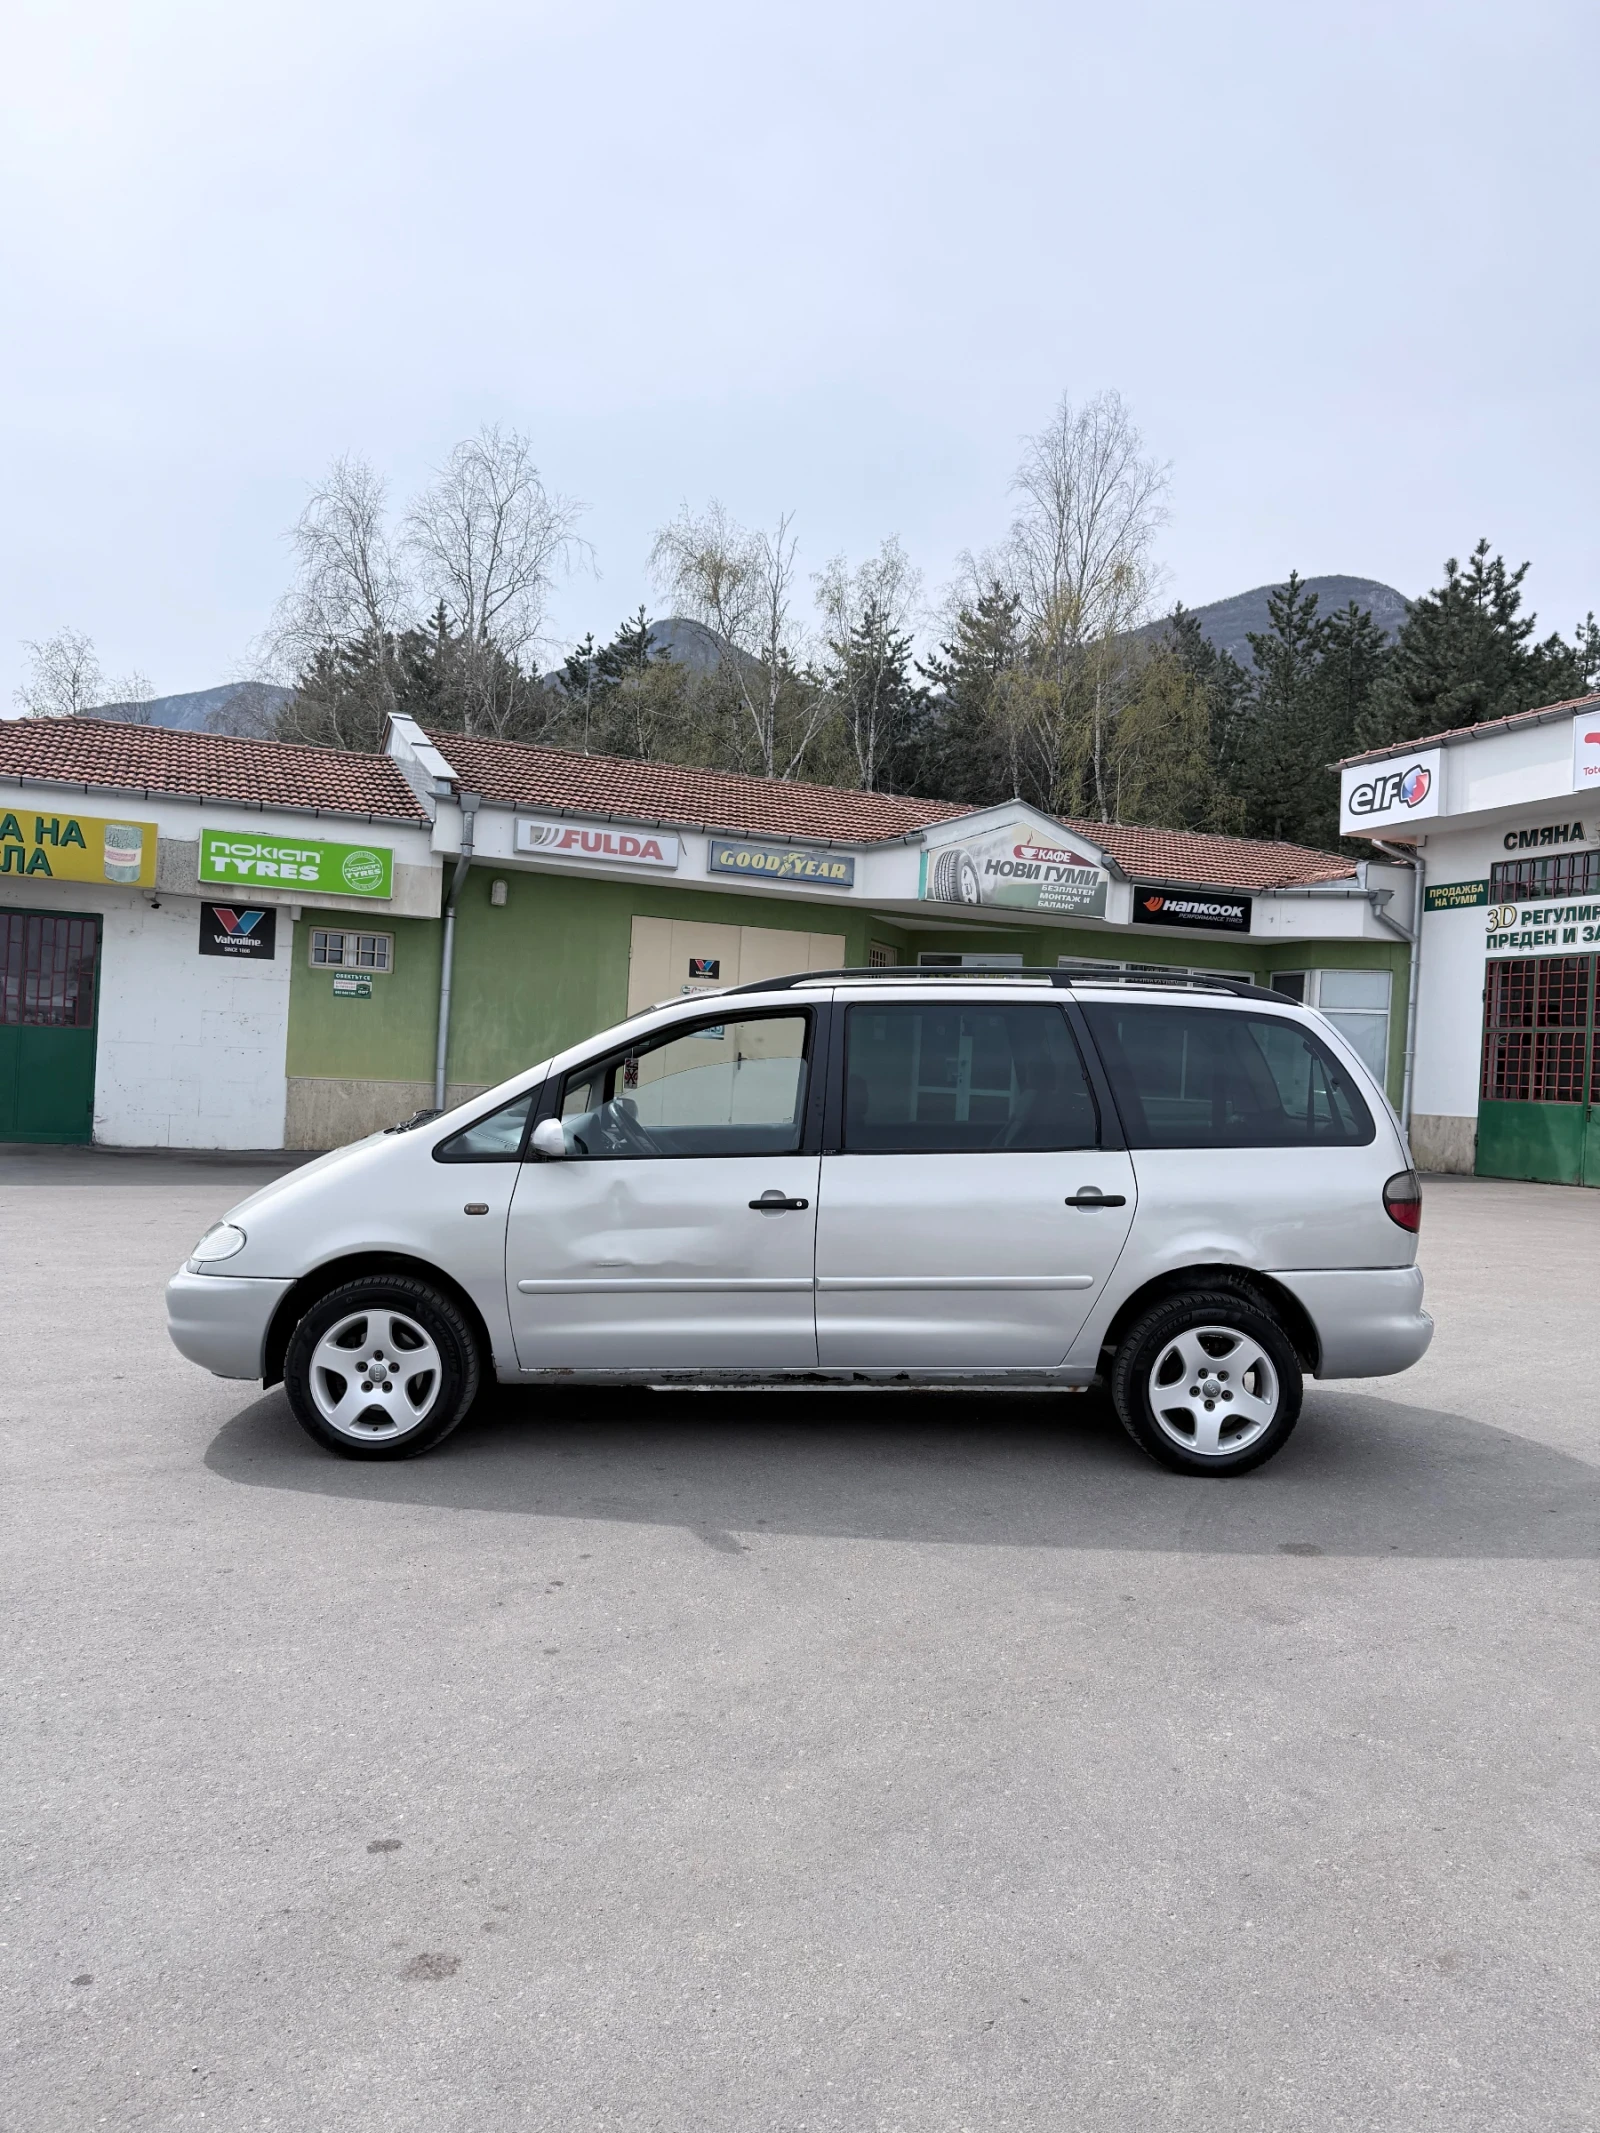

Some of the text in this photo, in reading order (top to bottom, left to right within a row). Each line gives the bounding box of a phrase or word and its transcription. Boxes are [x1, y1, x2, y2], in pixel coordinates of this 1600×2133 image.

[1348, 772, 1403, 815] elf
[35, 816, 87, 849] НА
[1503, 821, 1585, 851] СМЯНА
[554, 829, 664, 860] FULDA
[1038, 849, 1072, 862] КАФЕ
[210, 855, 319, 881] TYRES
[984, 859, 1100, 887] НОВИ ГУМИ
[1040, 892, 1081, 903] МОНТАЖ
[1041, 884, 1095, 896] БЕЗПЛАТЕН
[1429, 883, 1484, 899] ПРОДАЖБА
[1037, 900, 1075, 910] БАЛАНС
[1434, 894, 1477, 907] НА ГУМИ
[1178, 913, 1226, 922] PERFORMANCE
[1485, 905, 1517, 933] 3D
[214, 934, 262, 947] Valvoline
[1486, 929, 1558, 951] ПРЕДЕН
[1563, 927, 1577, 945] И
